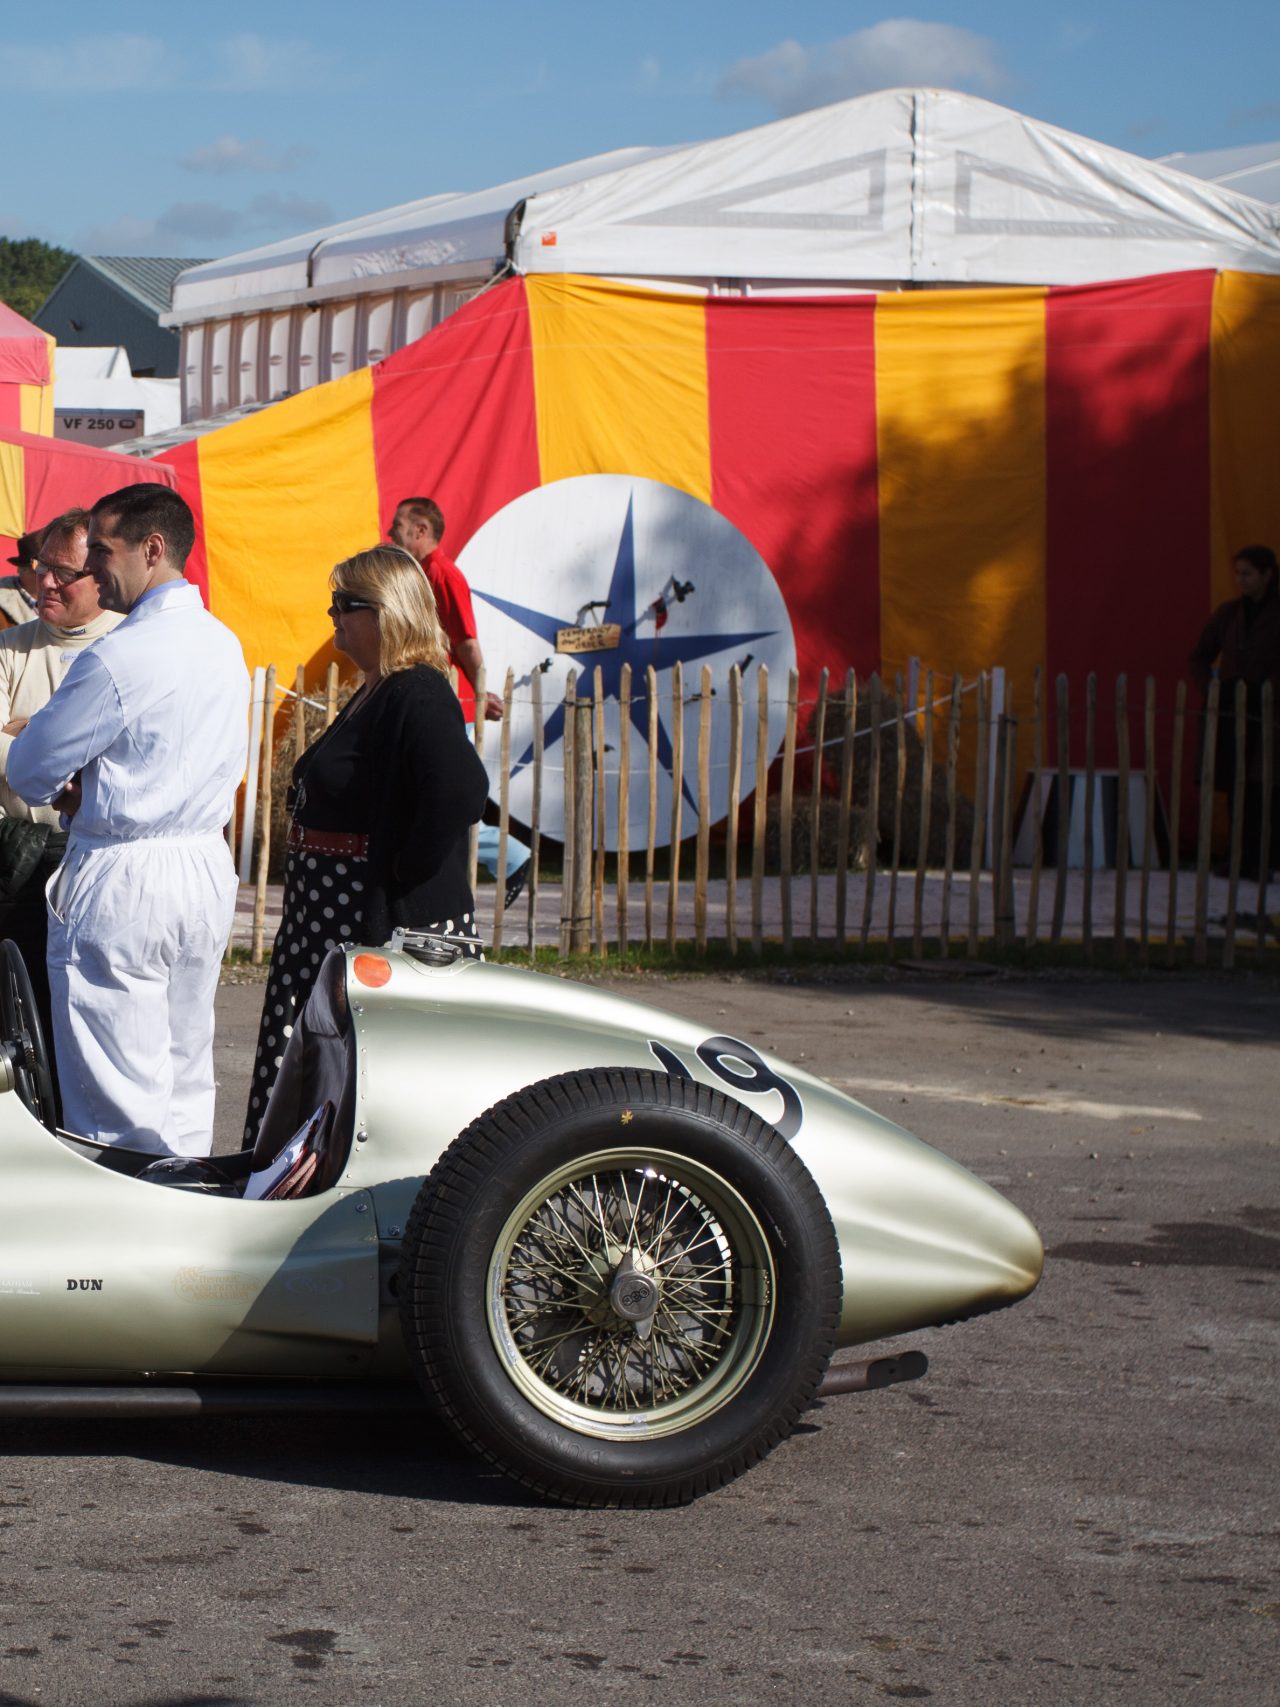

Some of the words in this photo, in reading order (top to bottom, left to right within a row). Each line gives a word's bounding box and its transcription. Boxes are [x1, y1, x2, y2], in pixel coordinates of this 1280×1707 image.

[63, 418, 83, 429] VF
[87, 418, 115, 430] 250
[66, 1279, 104, 1291] DUN
